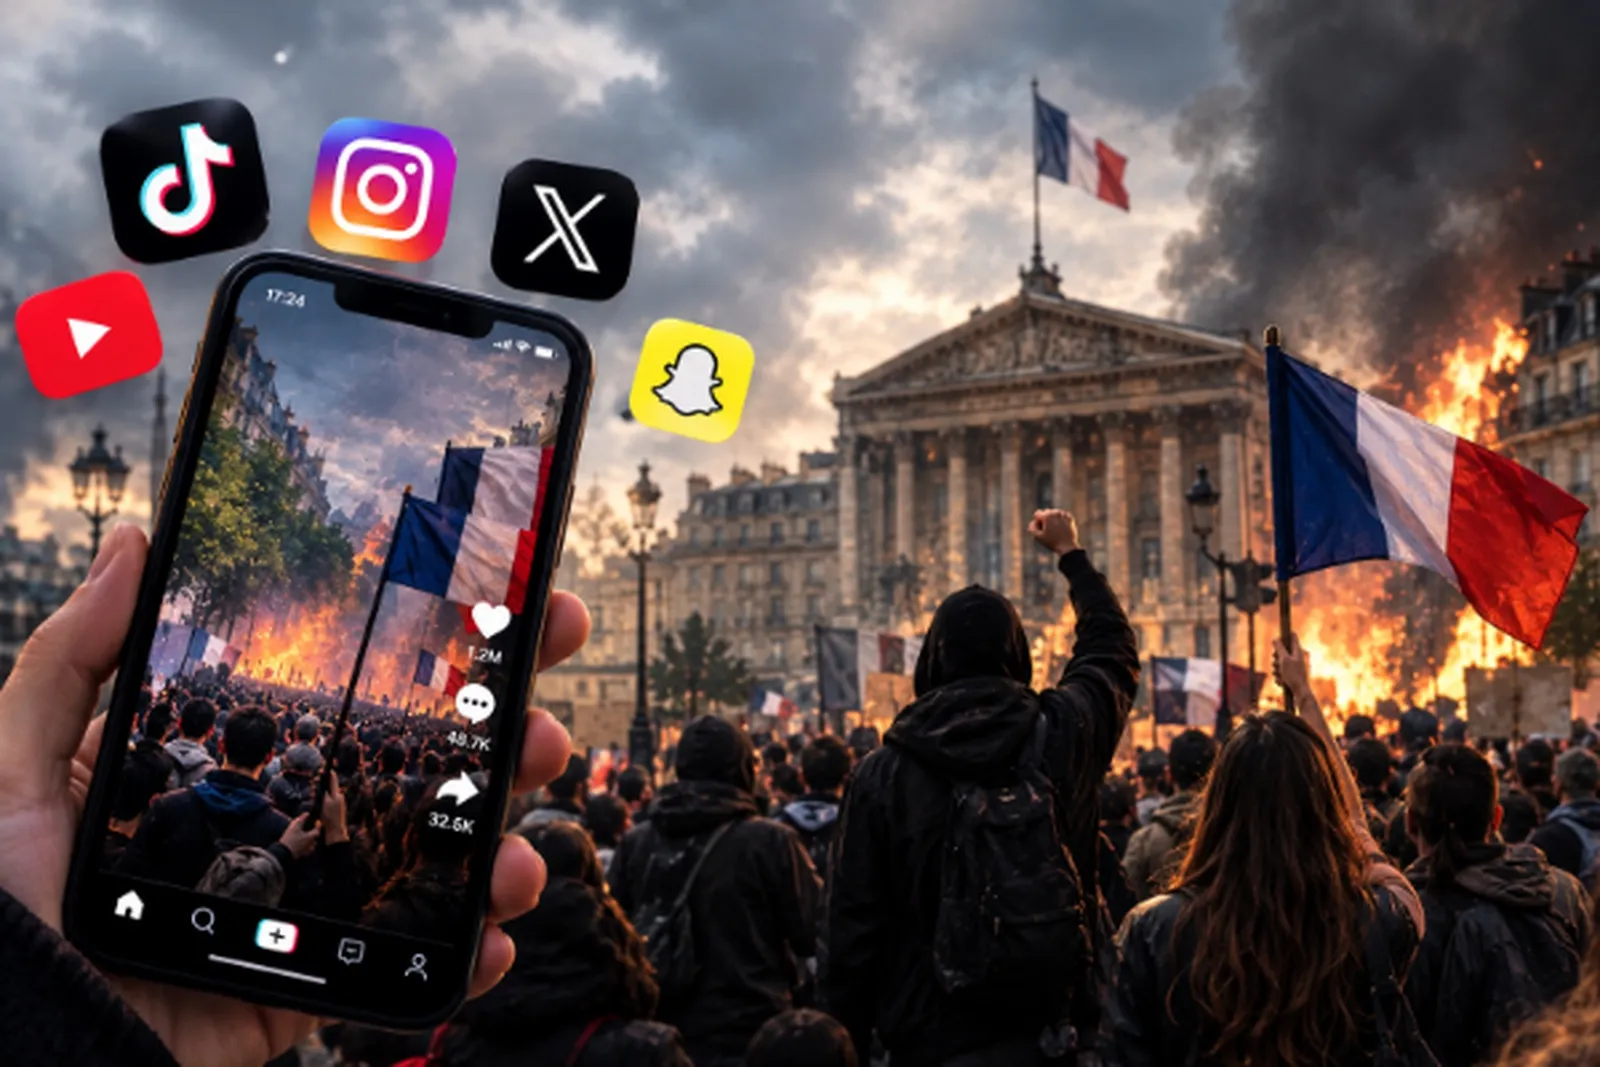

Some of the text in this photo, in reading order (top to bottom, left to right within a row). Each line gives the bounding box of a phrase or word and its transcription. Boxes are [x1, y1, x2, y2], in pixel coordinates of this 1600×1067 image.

[523, 184, 606, 274] X
[266, 288, 306, 309] 17:24
[468, 645, 502, 664] 1.2M
